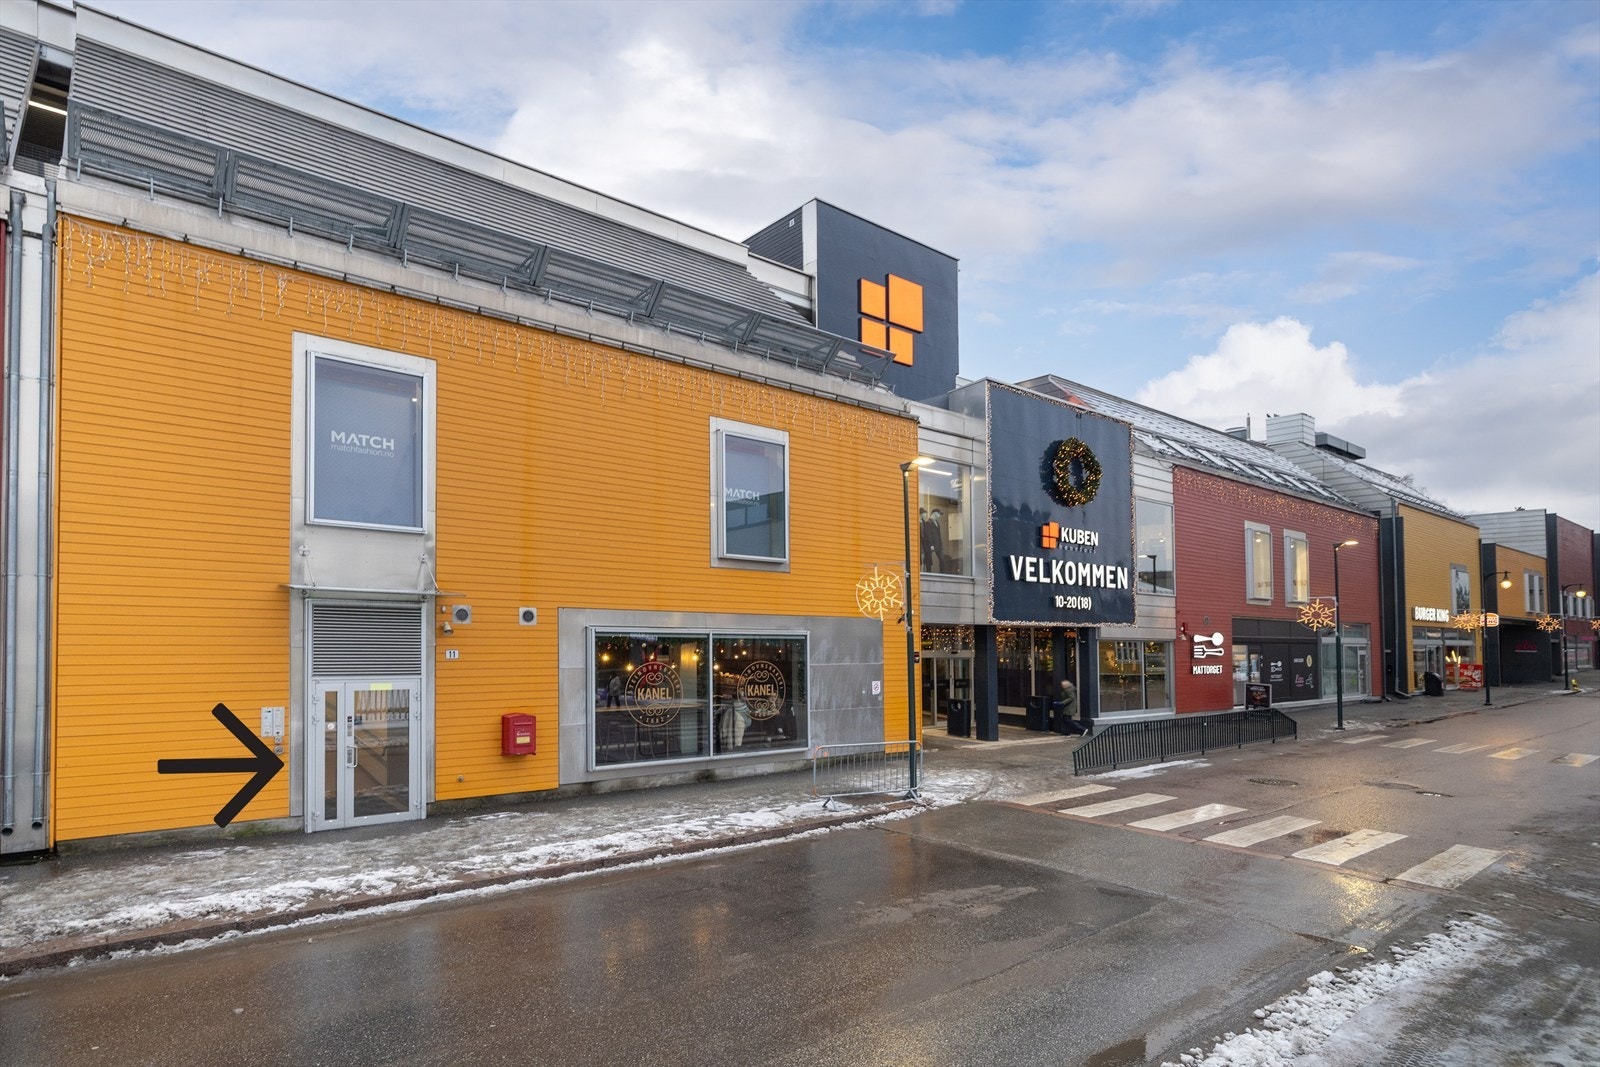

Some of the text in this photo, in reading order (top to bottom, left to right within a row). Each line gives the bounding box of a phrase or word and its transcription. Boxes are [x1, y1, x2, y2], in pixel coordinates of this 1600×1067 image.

[331, 430, 395, 450] MATCH
[330, 444, 395, 458] matchfashion.no
[725, 488, 760, 501] MATCH
[1061, 527, 1099, 547] KUBEN
[1010, 554, 1129, 590] VELKOMMEN
[1415, 606, 1450, 623] BURGER KING
[449, 651, 457, 659] 11
[1193, 665, 1223, 675] MATTORGET
[637, 687, 672, 701] KANEL
[747, 684, 776, 697] KANEL
